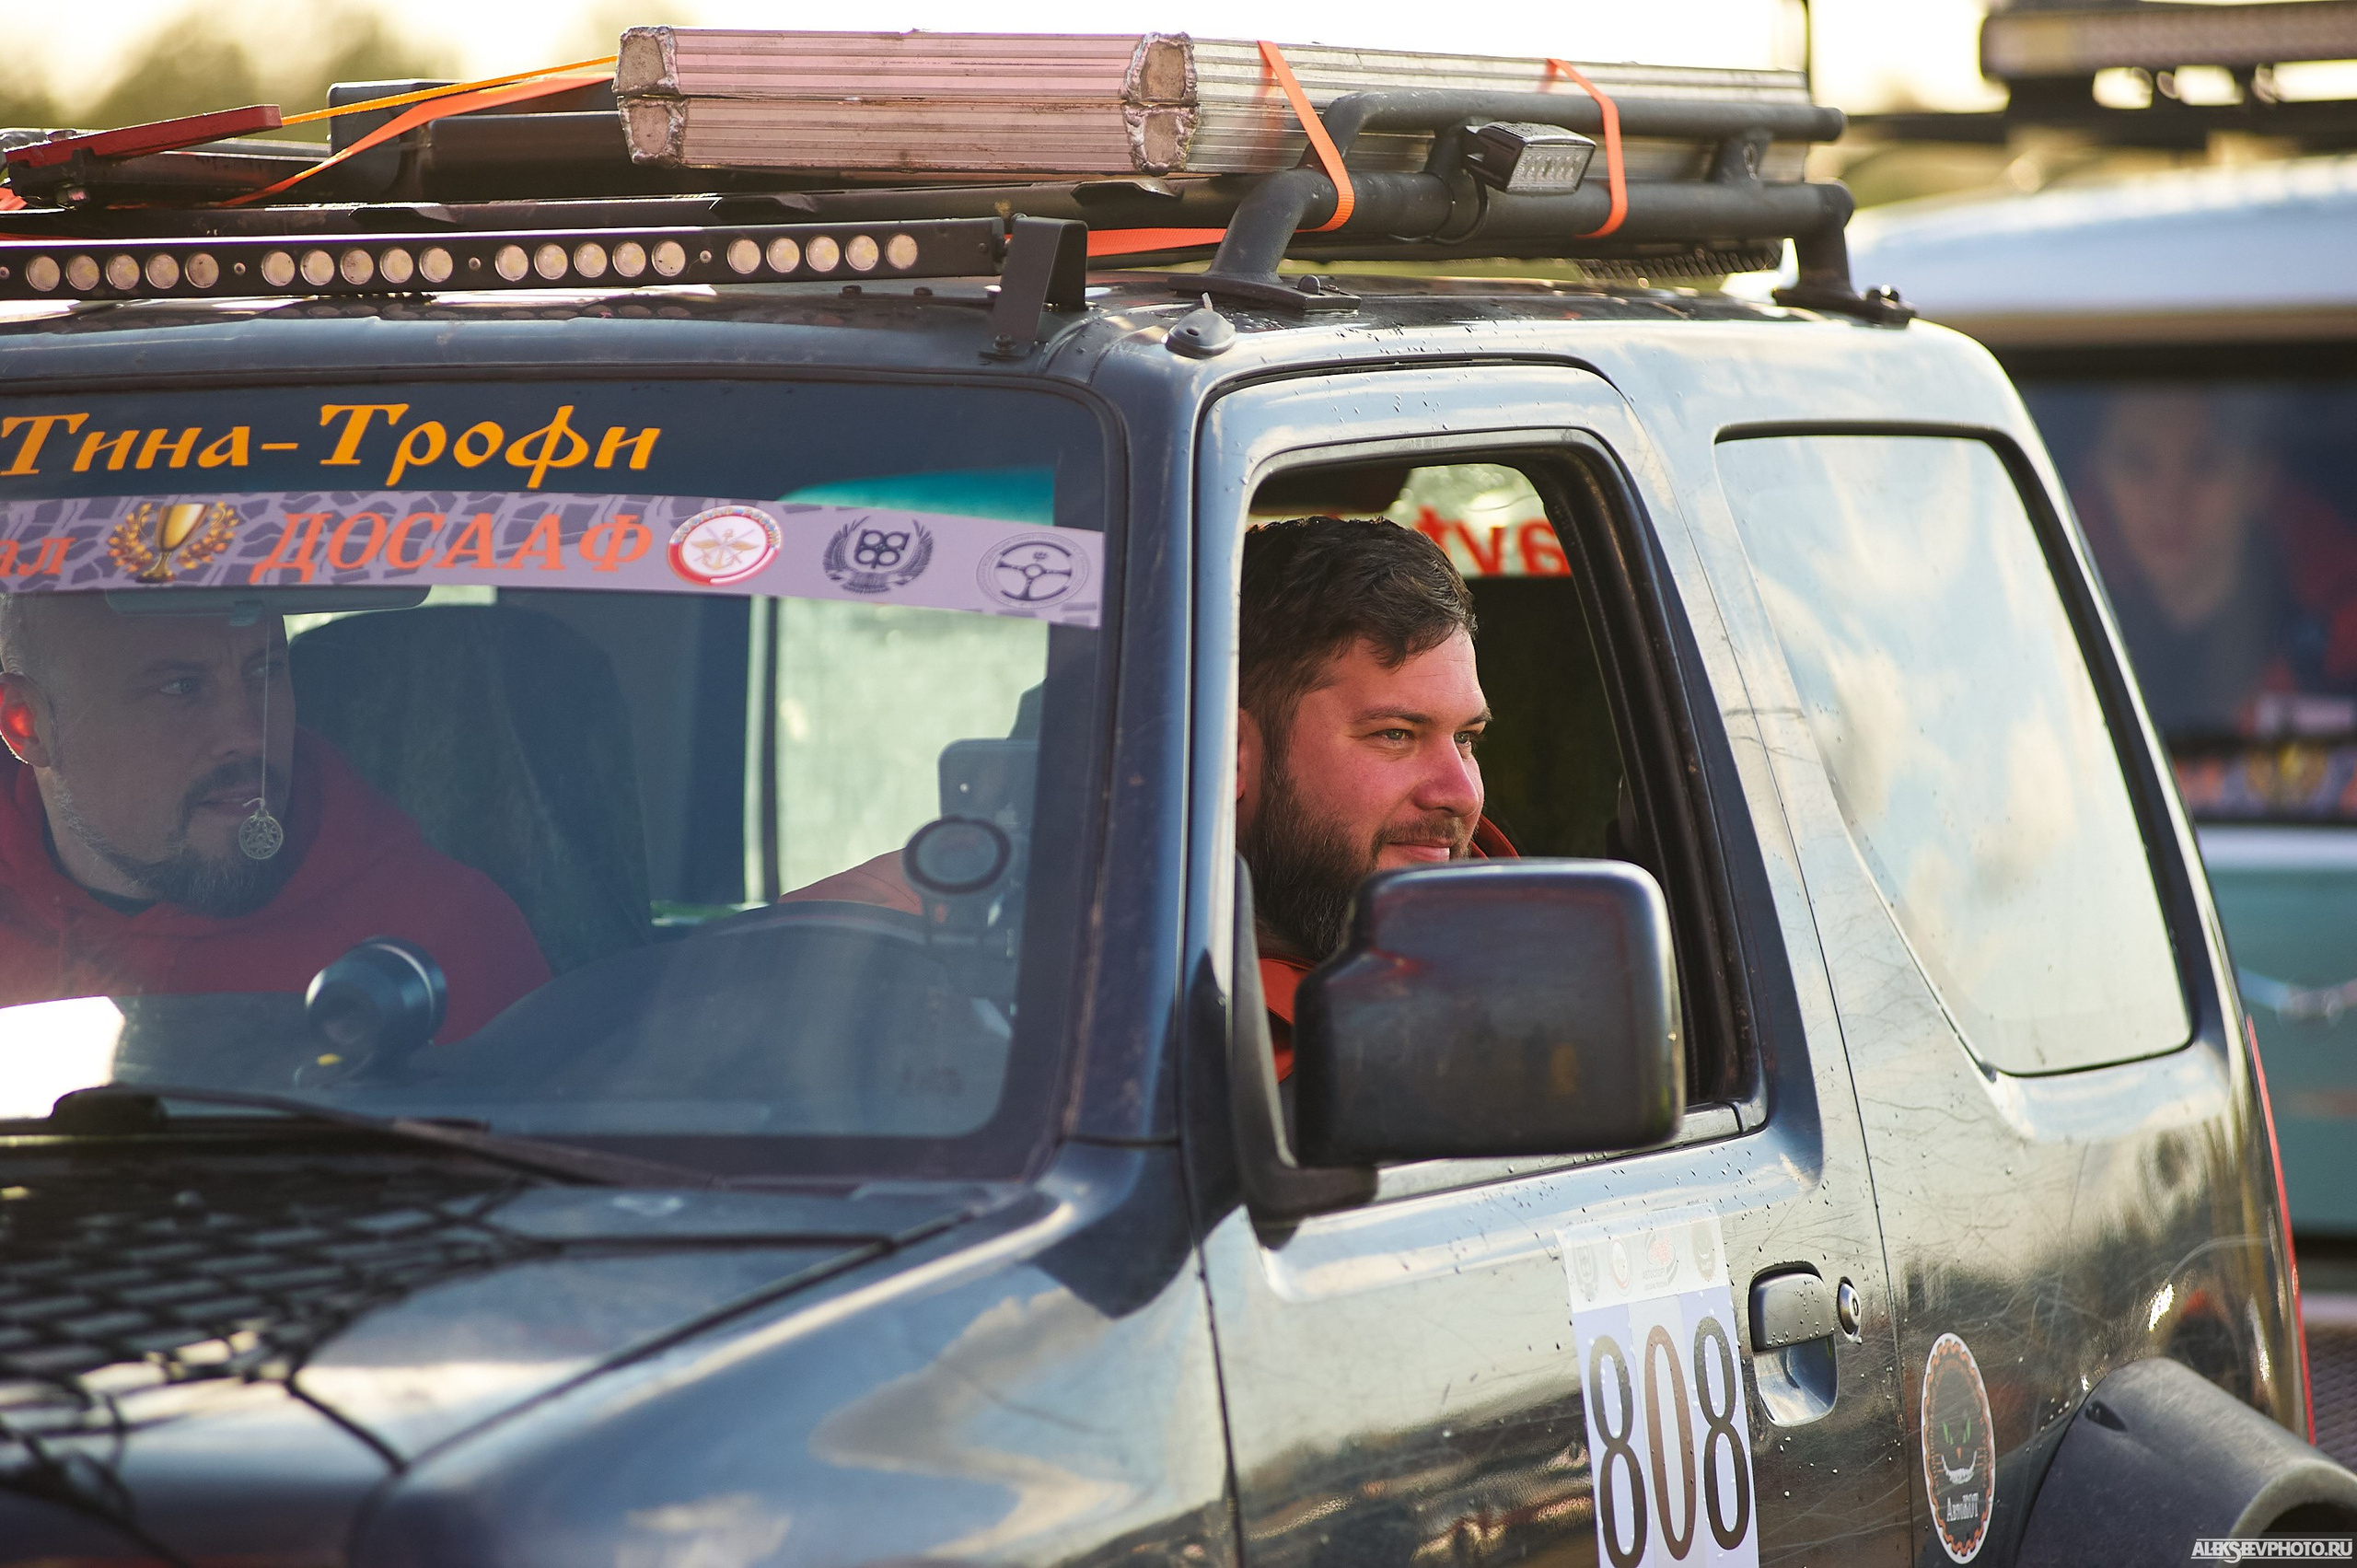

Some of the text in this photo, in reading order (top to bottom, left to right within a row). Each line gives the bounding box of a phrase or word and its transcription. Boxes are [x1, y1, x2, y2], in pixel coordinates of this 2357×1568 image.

[1, 403, 661, 489] Тина-Трофи
[250, 511, 653, 584] ДОСААФ
[1589, 1316, 1749, 1568] 808
